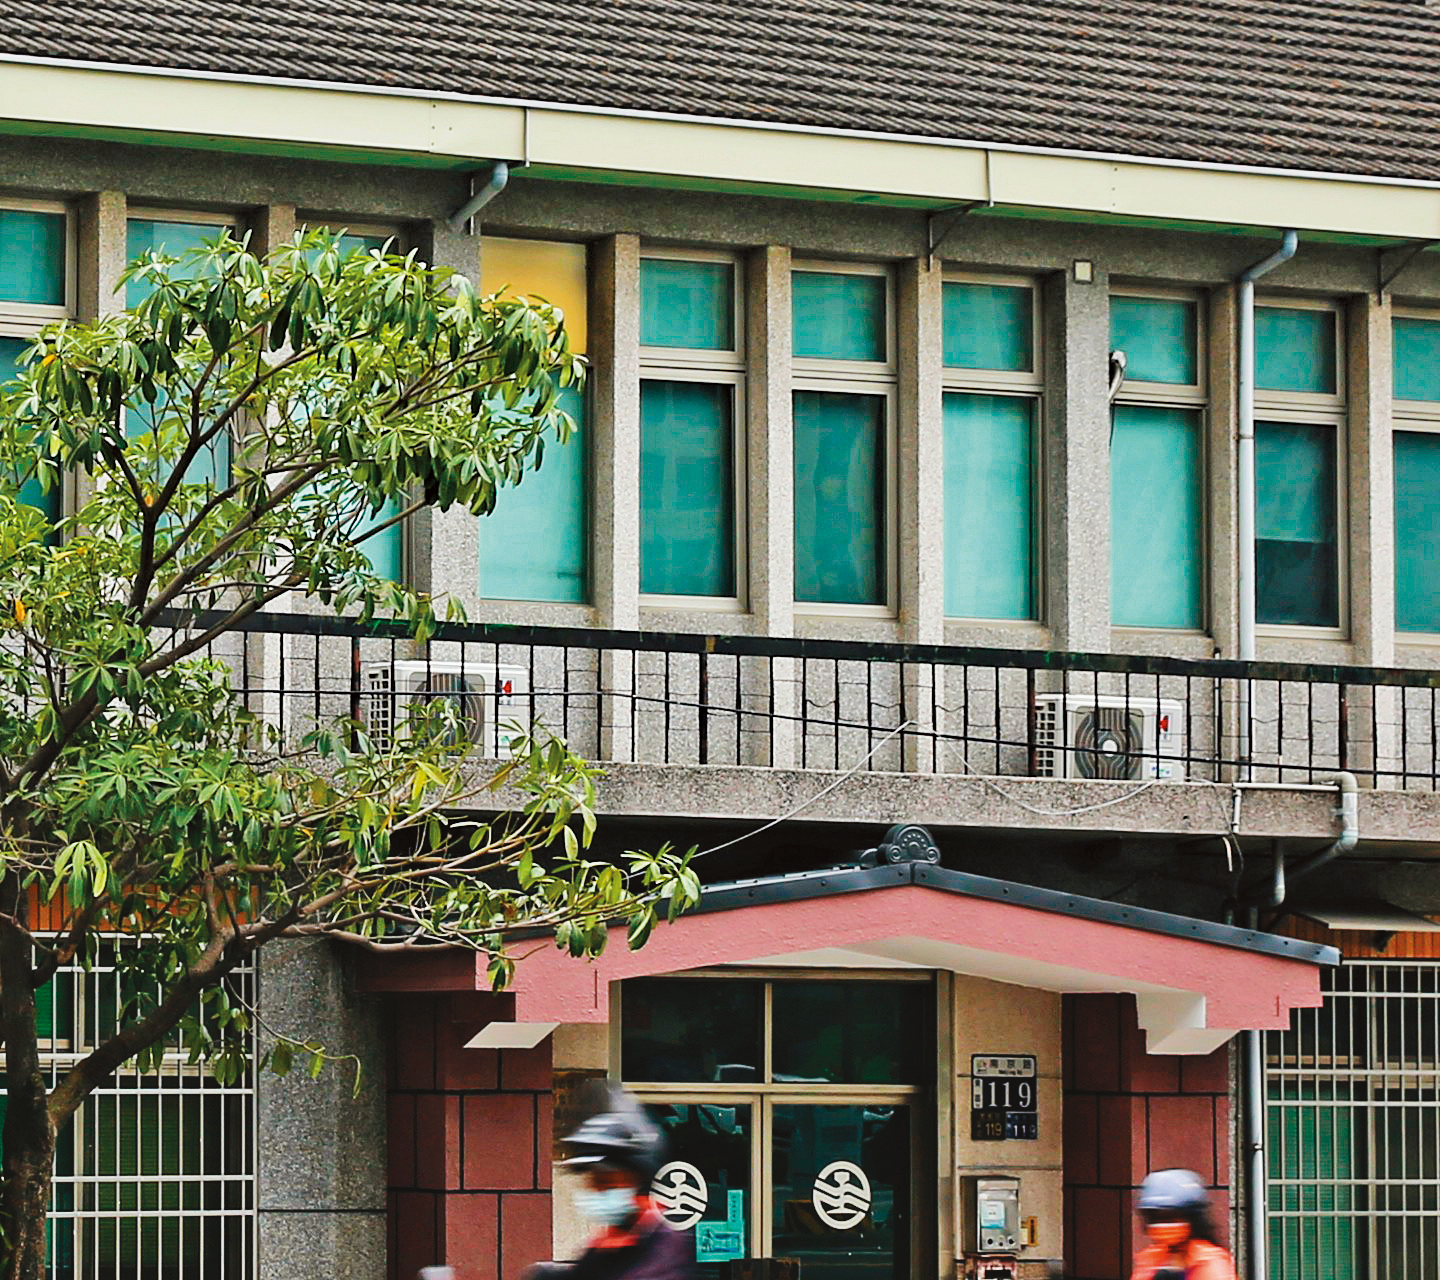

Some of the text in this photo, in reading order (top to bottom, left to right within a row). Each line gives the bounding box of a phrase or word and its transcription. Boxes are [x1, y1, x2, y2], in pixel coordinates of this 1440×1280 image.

[988, 1081, 1031, 1108] 119
[985, 1122, 1002, 1137] 119
[1013, 1124, 1037, 1138] 119
